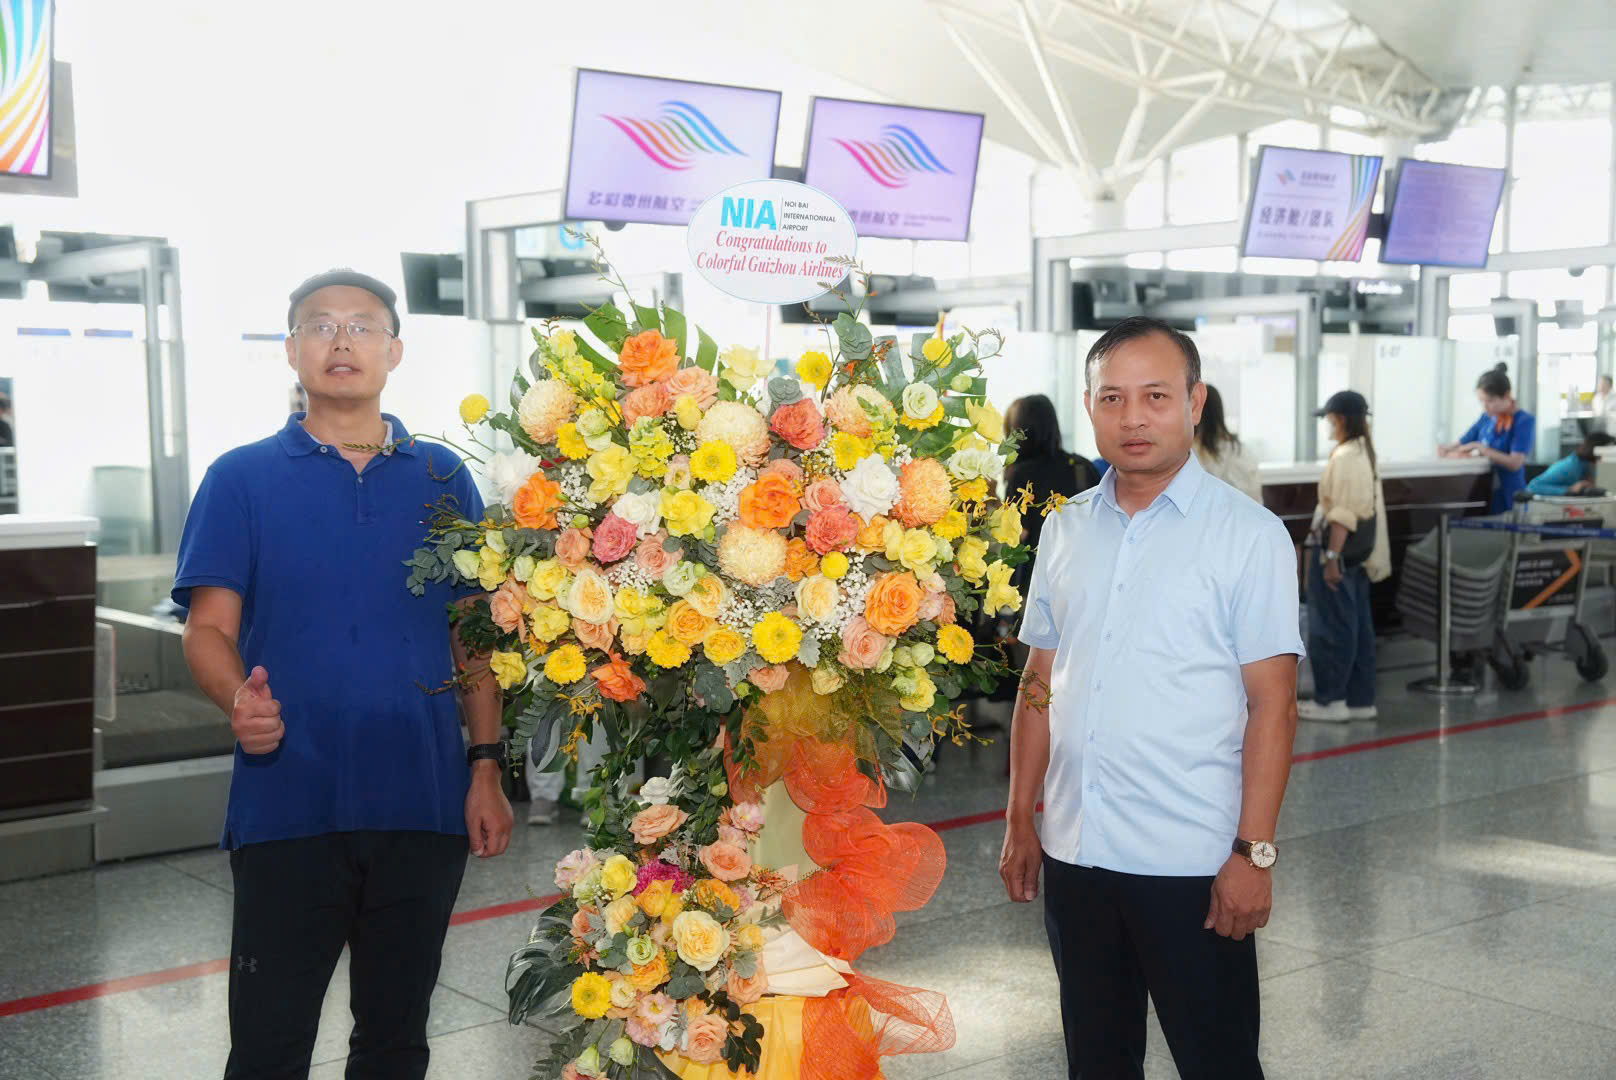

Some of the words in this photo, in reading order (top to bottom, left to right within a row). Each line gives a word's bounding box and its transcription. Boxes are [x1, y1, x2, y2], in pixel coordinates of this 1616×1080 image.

[720, 197, 776, 230] NIA
[783, 212, 836, 222] INTERNATIONNAL
[782, 224, 808, 232] AIRPORT
[716, 230, 812, 254] Congratulations
[816, 239, 828, 254] to
[697, 252, 746, 274] Colorful
[749, 255, 797, 275] Guizhou
[799, 260, 844, 279] Airlines
